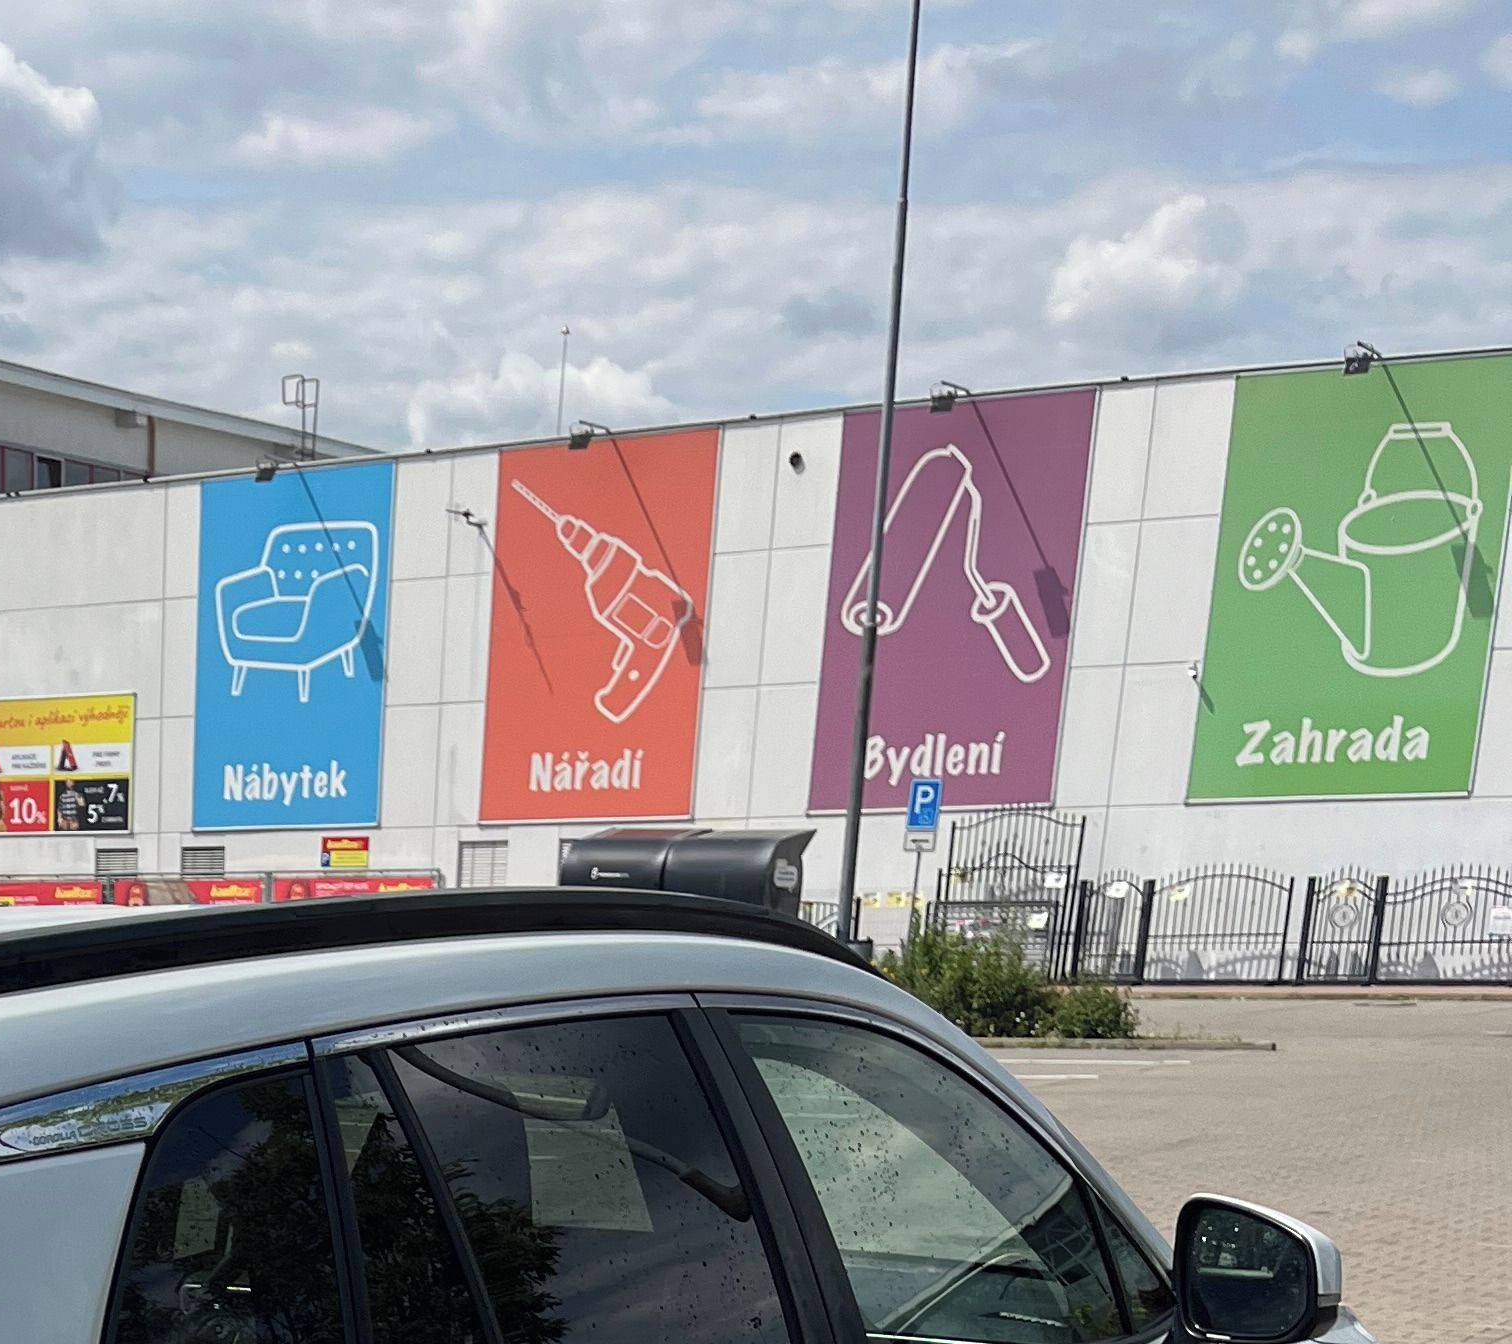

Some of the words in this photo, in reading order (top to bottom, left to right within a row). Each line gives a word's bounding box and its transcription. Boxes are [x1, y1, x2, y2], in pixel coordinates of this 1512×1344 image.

[863, 731, 1006, 787] Bydlení
[1234, 715, 1431, 768] Zahrada
[223, 759, 348, 806] Nábytek
[529, 748, 645, 793] Nářadí
[914, 784, 935, 815] P
